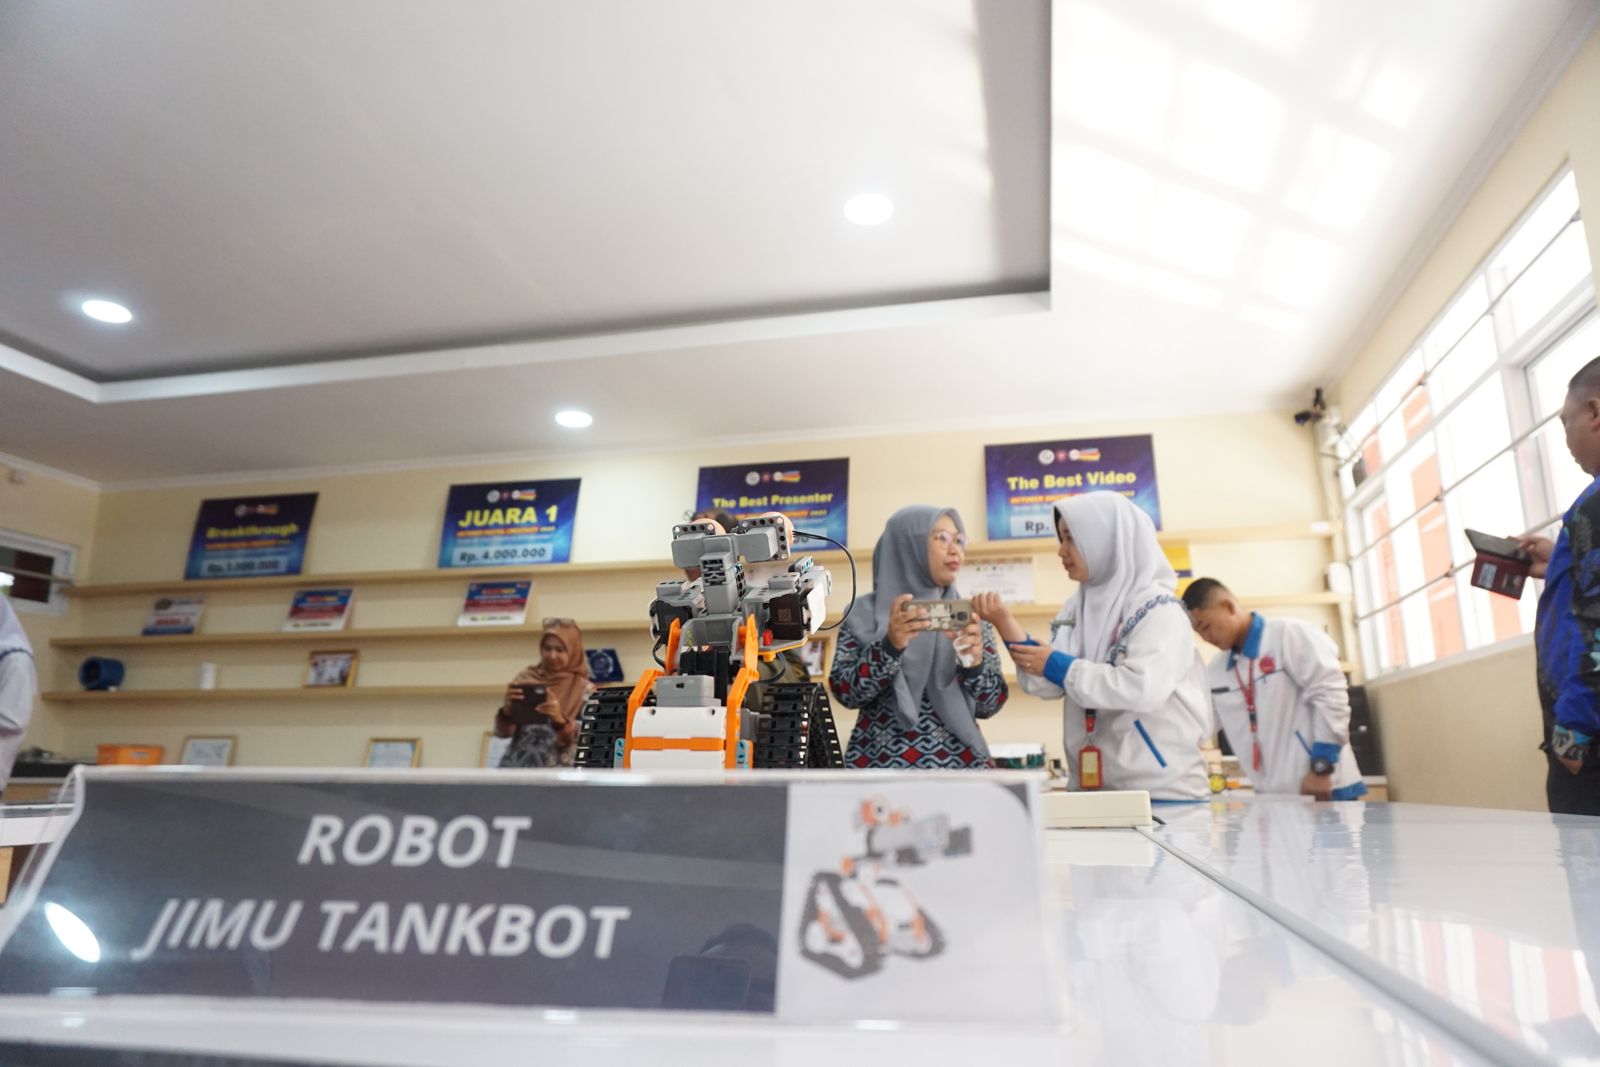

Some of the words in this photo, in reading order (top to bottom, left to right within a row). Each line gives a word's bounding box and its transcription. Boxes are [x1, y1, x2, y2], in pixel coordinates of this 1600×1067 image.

[1007, 476, 1039, 490] The
[1043, 474, 1082, 488] Best
[1086, 470, 1136, 485] Video
[712, 497, 736, 508] The
[739, 496, 768, 508] Best
[771, 493, 833, 506] Presenter
[458, 506, 537, 527] JUARA
[546, 504, 558, 523] 1
[1025, 521, 1049, 533] Rp.
[460, 552, 478, 563] Rp.
[482, 548, 546, 561] 4.000.000
[297, 814, 532, 868] ROBOT
[131, 899, 303, 961] JIMU
[318, 901, 631, 958] TANKBOT
